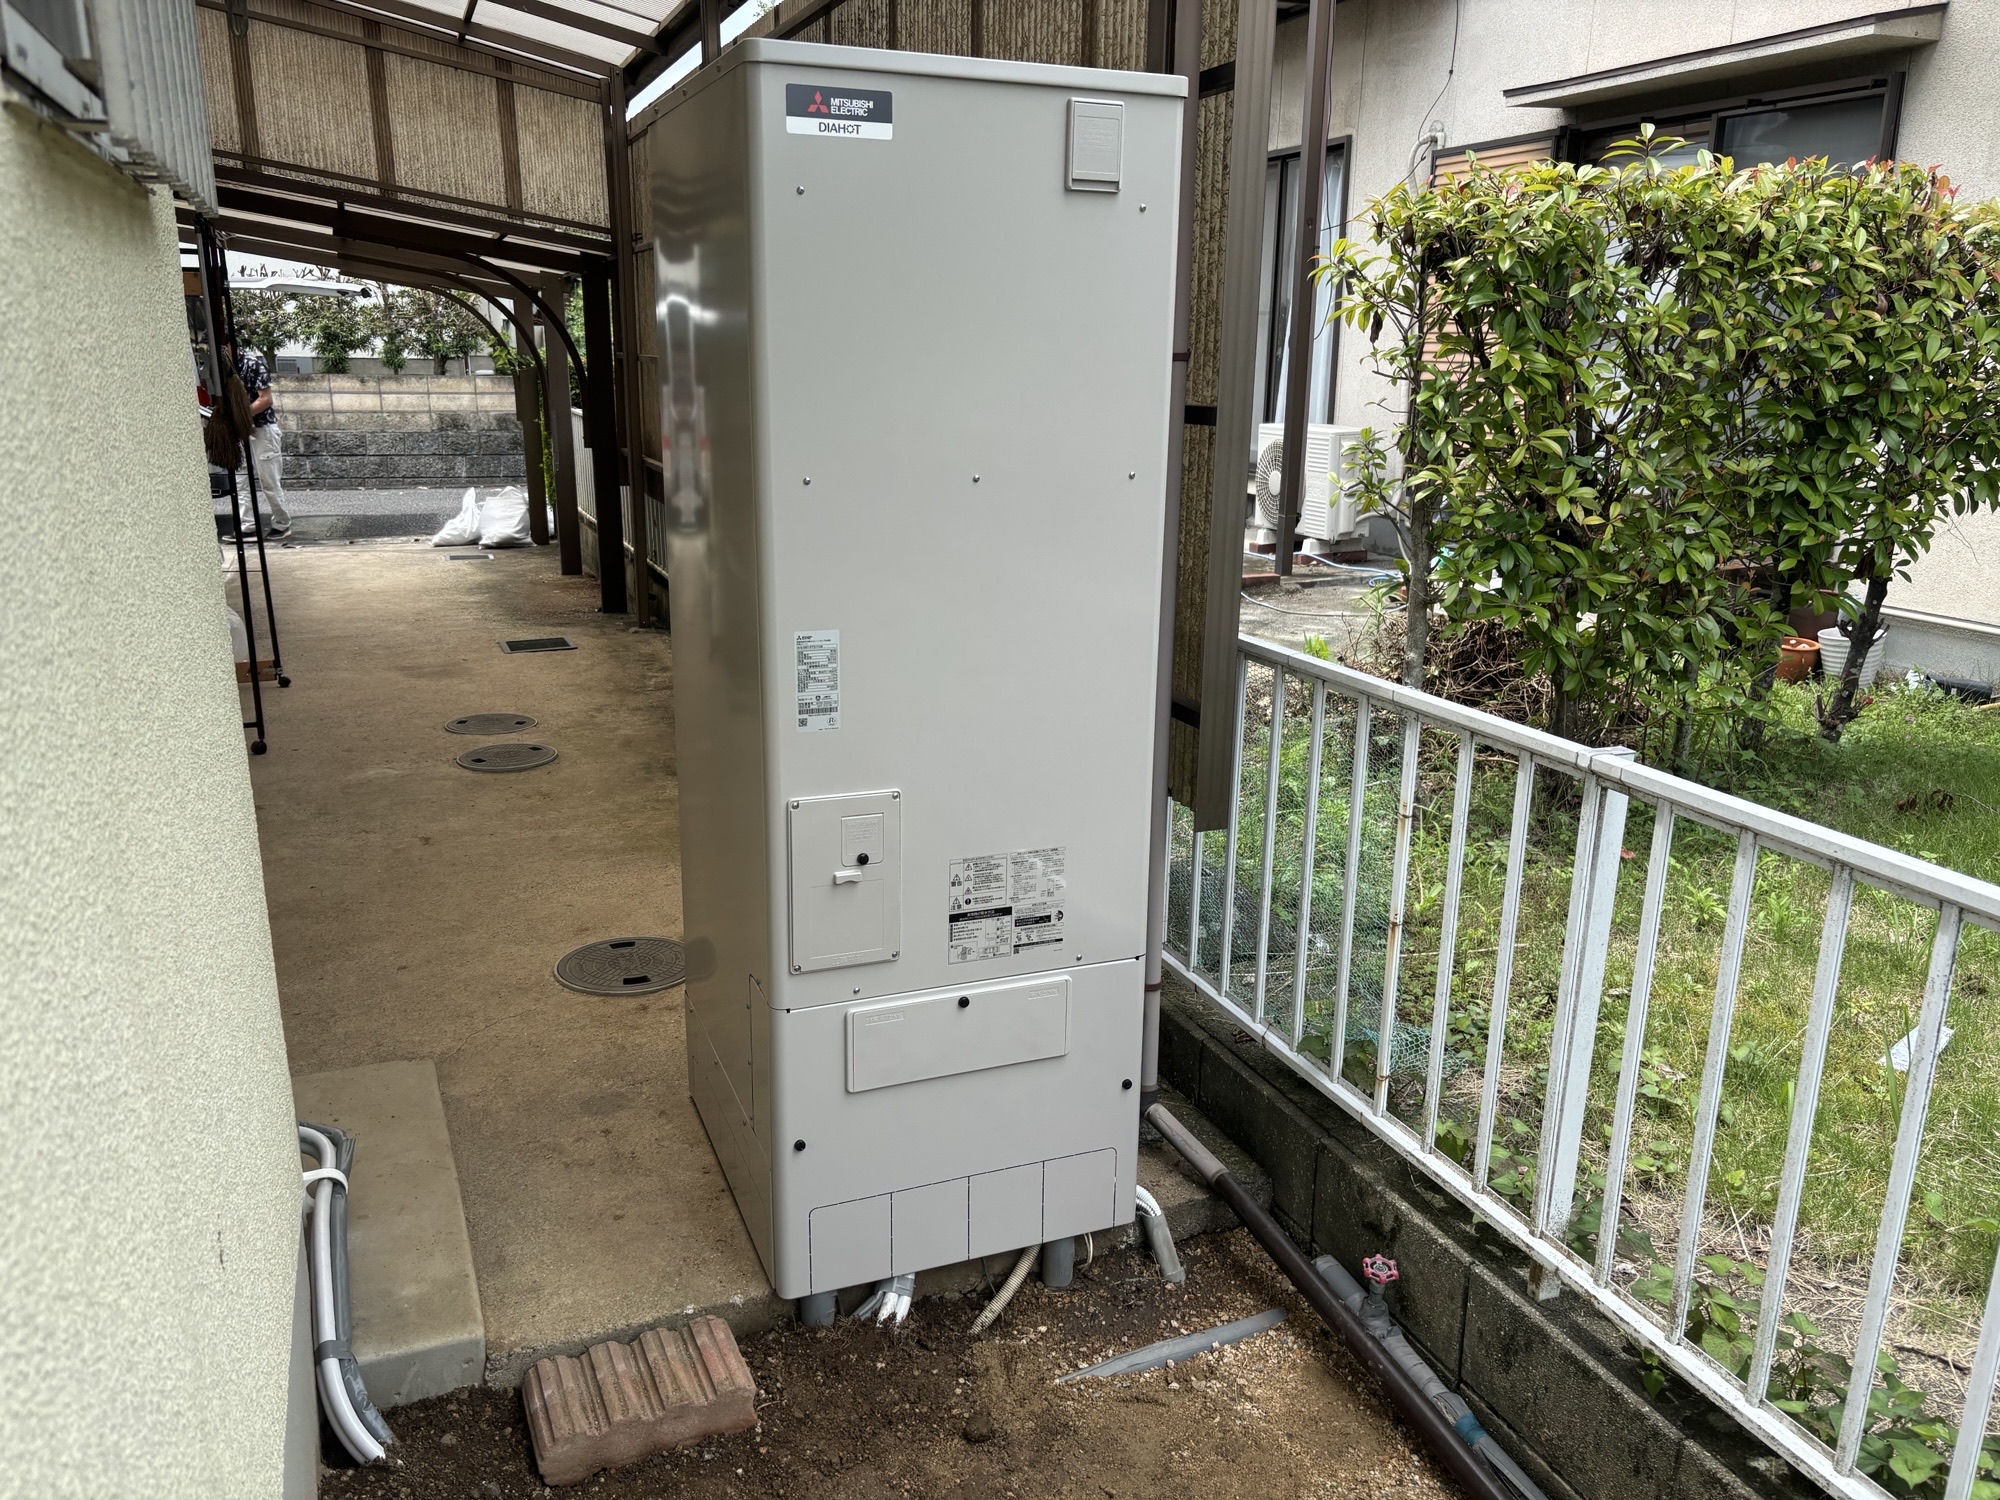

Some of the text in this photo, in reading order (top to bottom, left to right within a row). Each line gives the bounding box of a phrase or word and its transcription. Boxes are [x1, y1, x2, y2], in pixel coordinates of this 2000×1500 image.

[830, 97, 874, 109] MITSUBISHI
[830, 106, 868, 116] ELECTRIC
[819, 122, 861, 134] DIAHOT
